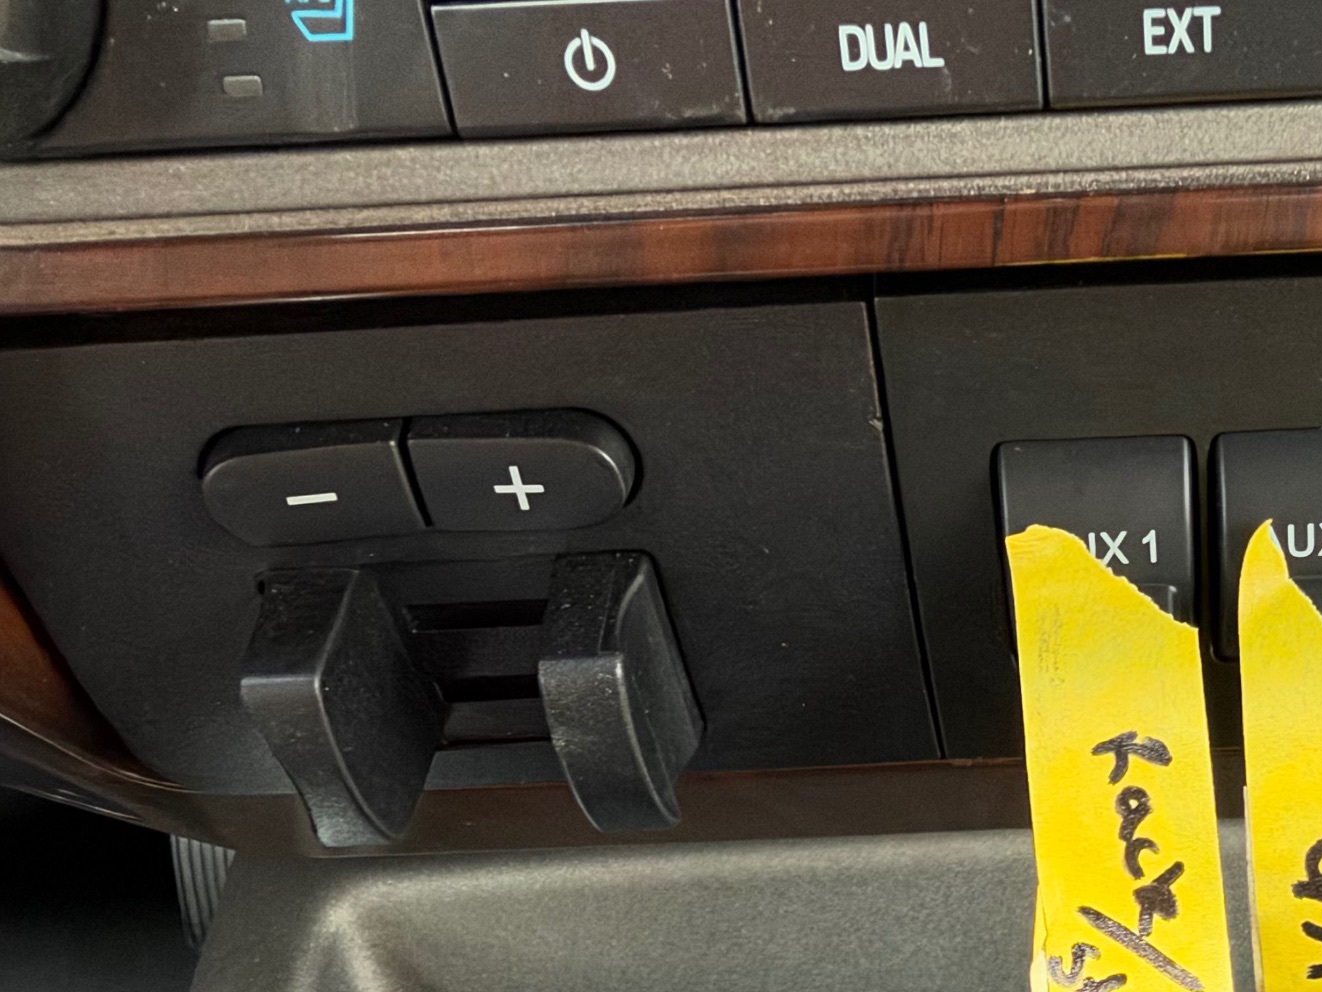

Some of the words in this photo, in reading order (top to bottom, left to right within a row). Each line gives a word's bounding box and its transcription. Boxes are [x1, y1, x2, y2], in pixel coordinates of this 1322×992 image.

[837, 21, 945, 72] DUAL
[1143, 7, 1221, 56] EXT
[1141, 529, 1158, 564] 1
